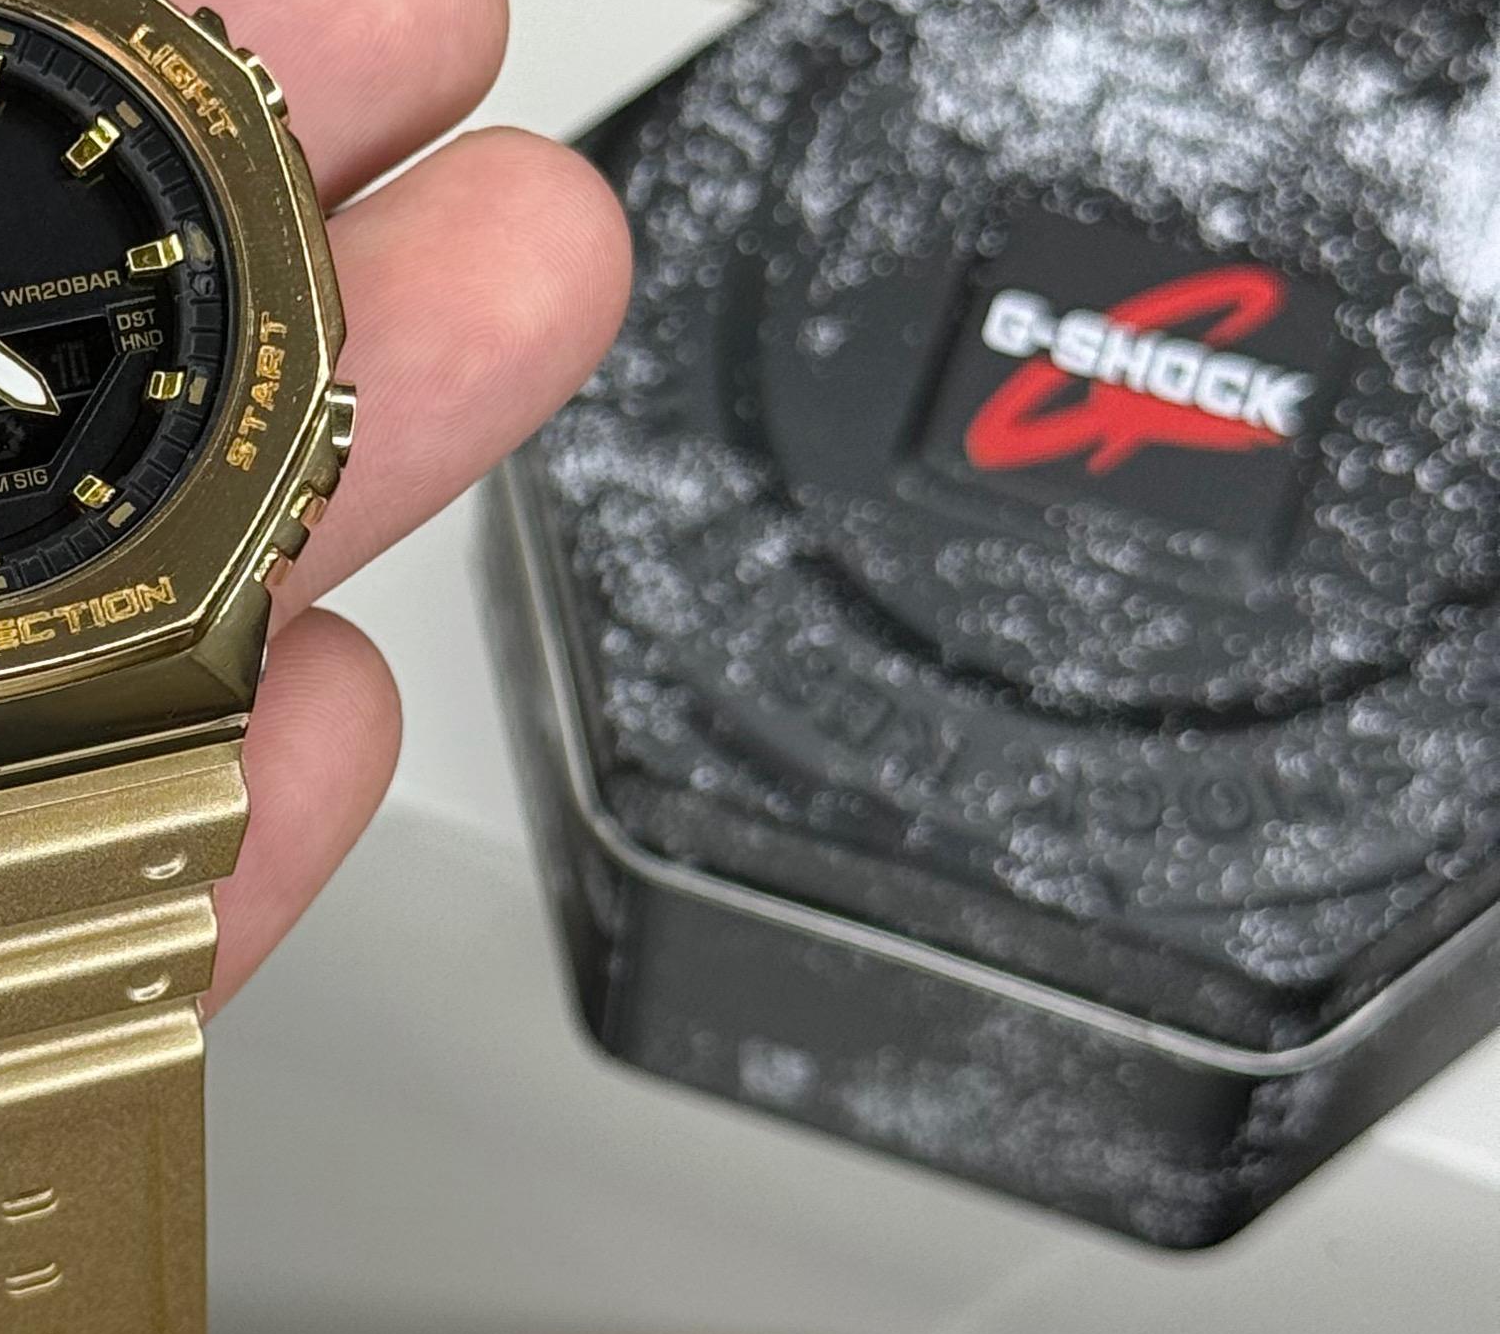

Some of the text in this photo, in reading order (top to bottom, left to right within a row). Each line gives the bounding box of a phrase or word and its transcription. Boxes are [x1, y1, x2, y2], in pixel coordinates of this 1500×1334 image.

[130, 24, 239, 138] LIGHT
[116, 309, 155, 331] DST
[120, 330, 163, 352] HND
[226, 311, 288, 470] START
[982, 288, 1317, 437] G-SHOCK
[13, 468, 49, 490] SIG
